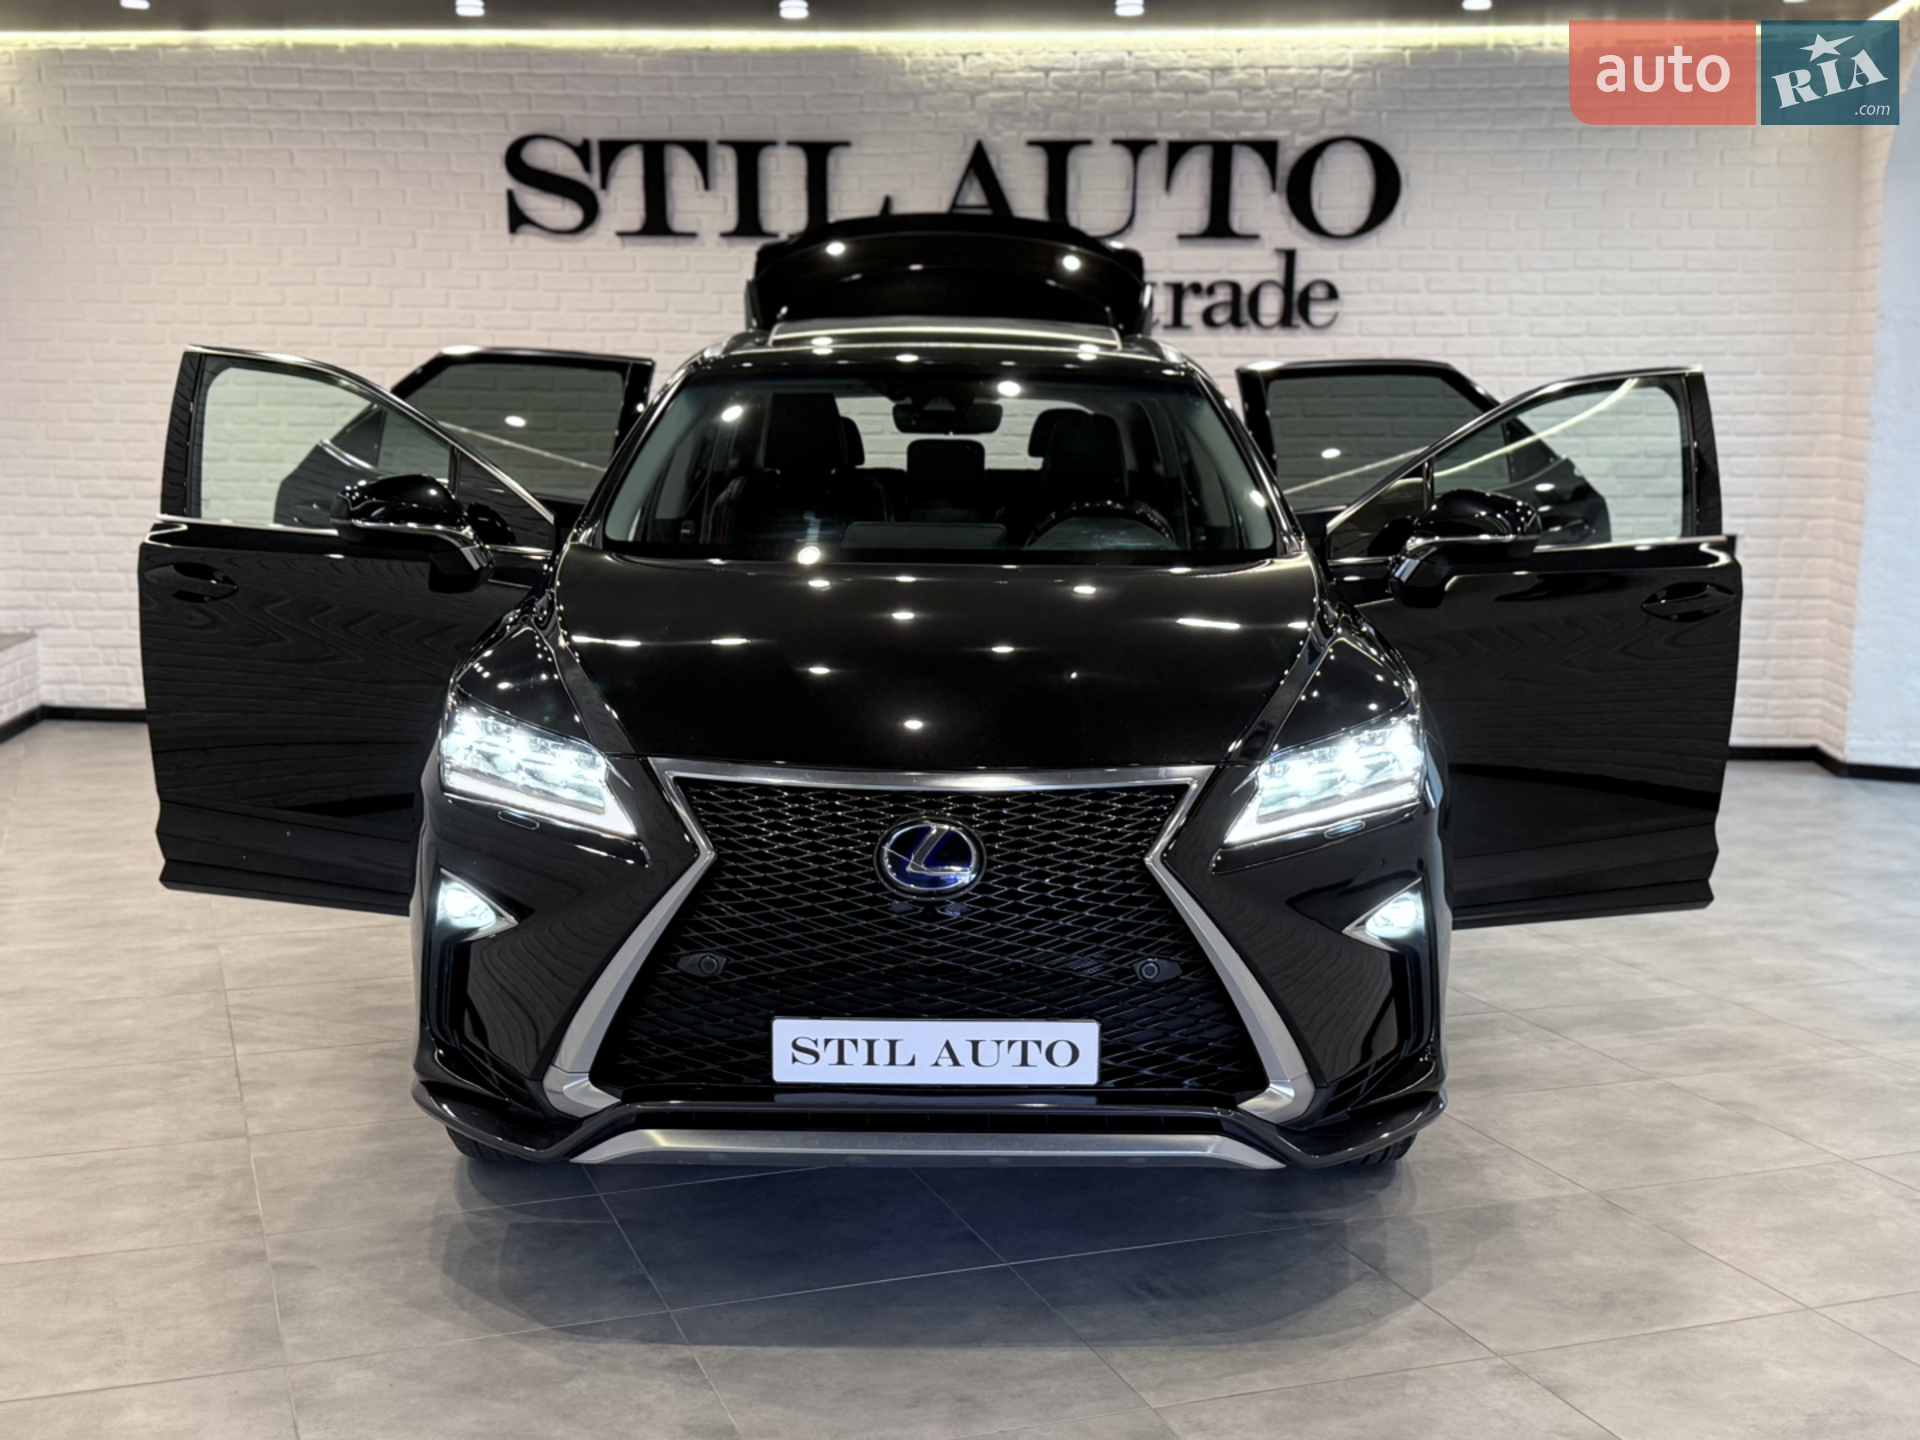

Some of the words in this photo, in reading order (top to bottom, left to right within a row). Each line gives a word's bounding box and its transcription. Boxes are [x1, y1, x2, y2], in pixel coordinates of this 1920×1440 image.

[505, 134, 891, 238] STIL
[946, 136, 1402, 240] AUTO
[1146, 248, 1340, 329] rade
[791, 1036, 916, 1066] STIL
[930, 1038, 1080, 1068] AUTO
